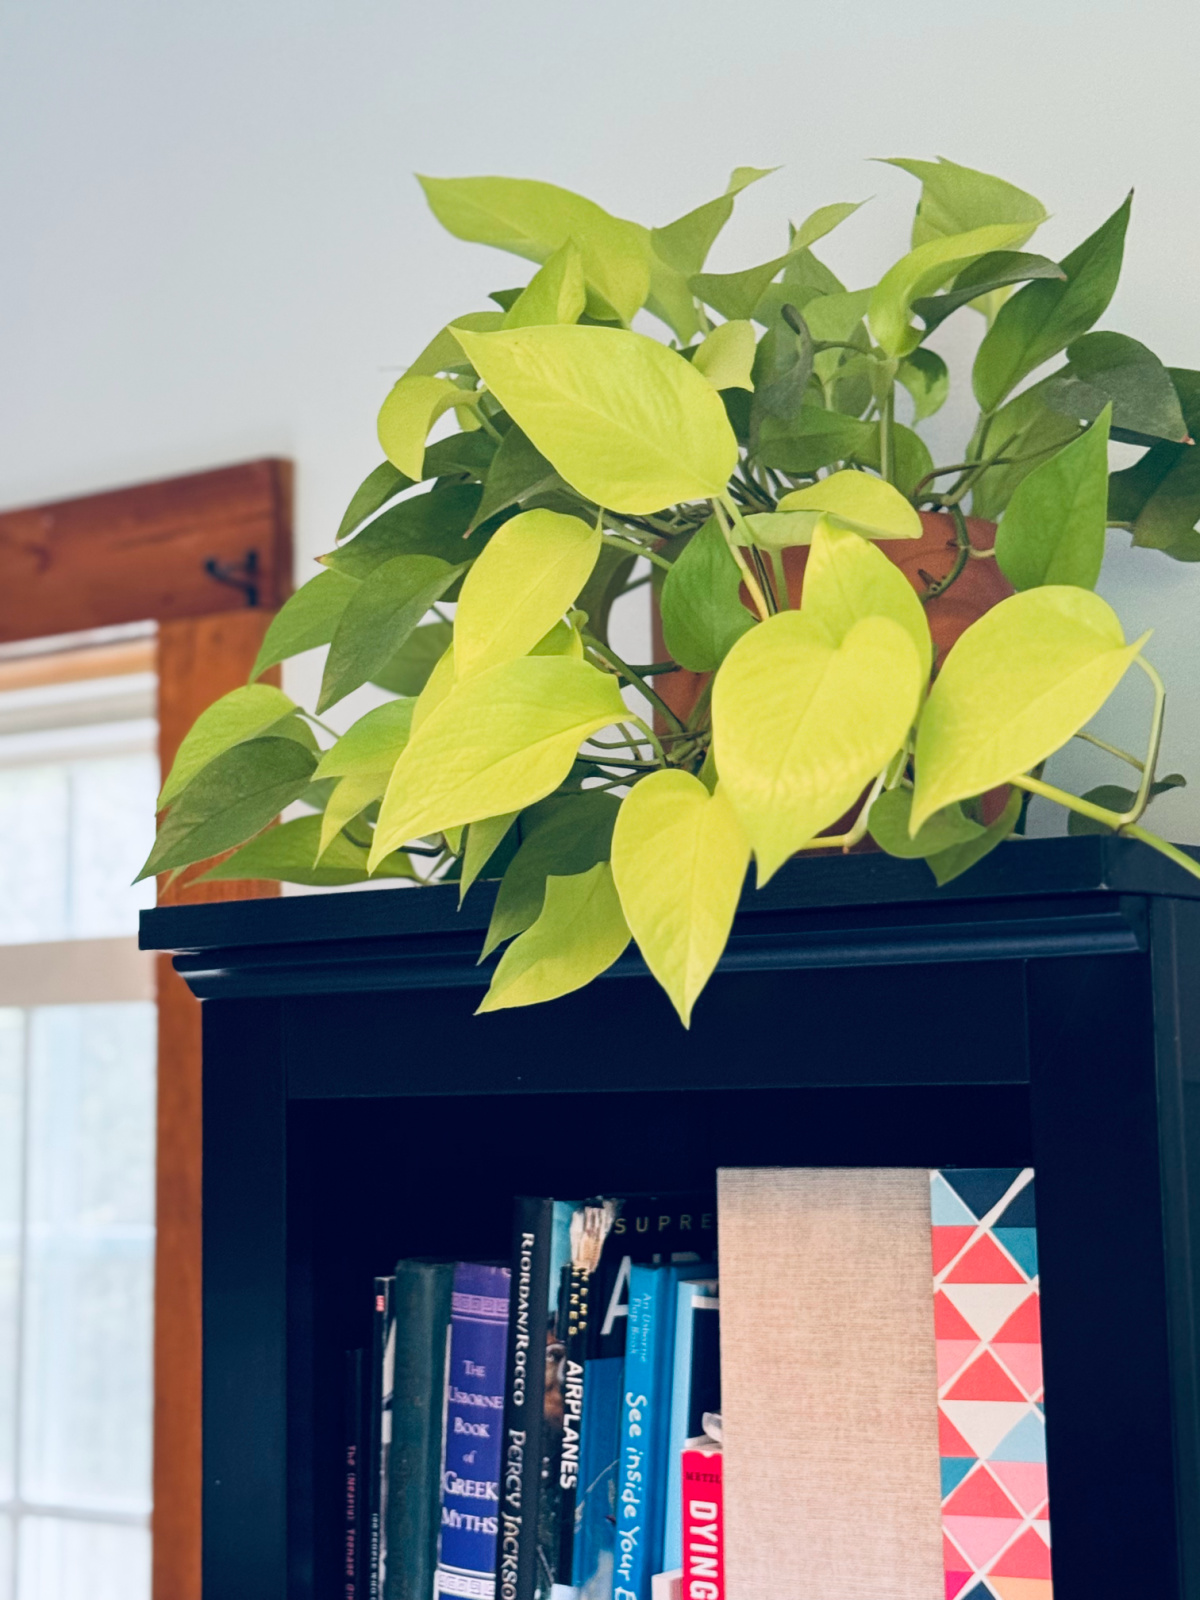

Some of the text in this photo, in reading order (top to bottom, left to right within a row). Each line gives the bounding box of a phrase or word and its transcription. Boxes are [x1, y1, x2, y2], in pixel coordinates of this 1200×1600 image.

[614, 1213, 712, 1234] SUPRE
[513, 1233, 535, 1406] RIORDAN/ROCCO
[560, 1360, 583, 1489] AIRPLANES
[625, 1392, 648, 1437] See
[505, 1429, 526, 1508] PERCY
[621, 1447, 644, 1518] inside
[617, 1526, 640, 1581] Your
[689, 1500, 719, 1600] DYING
